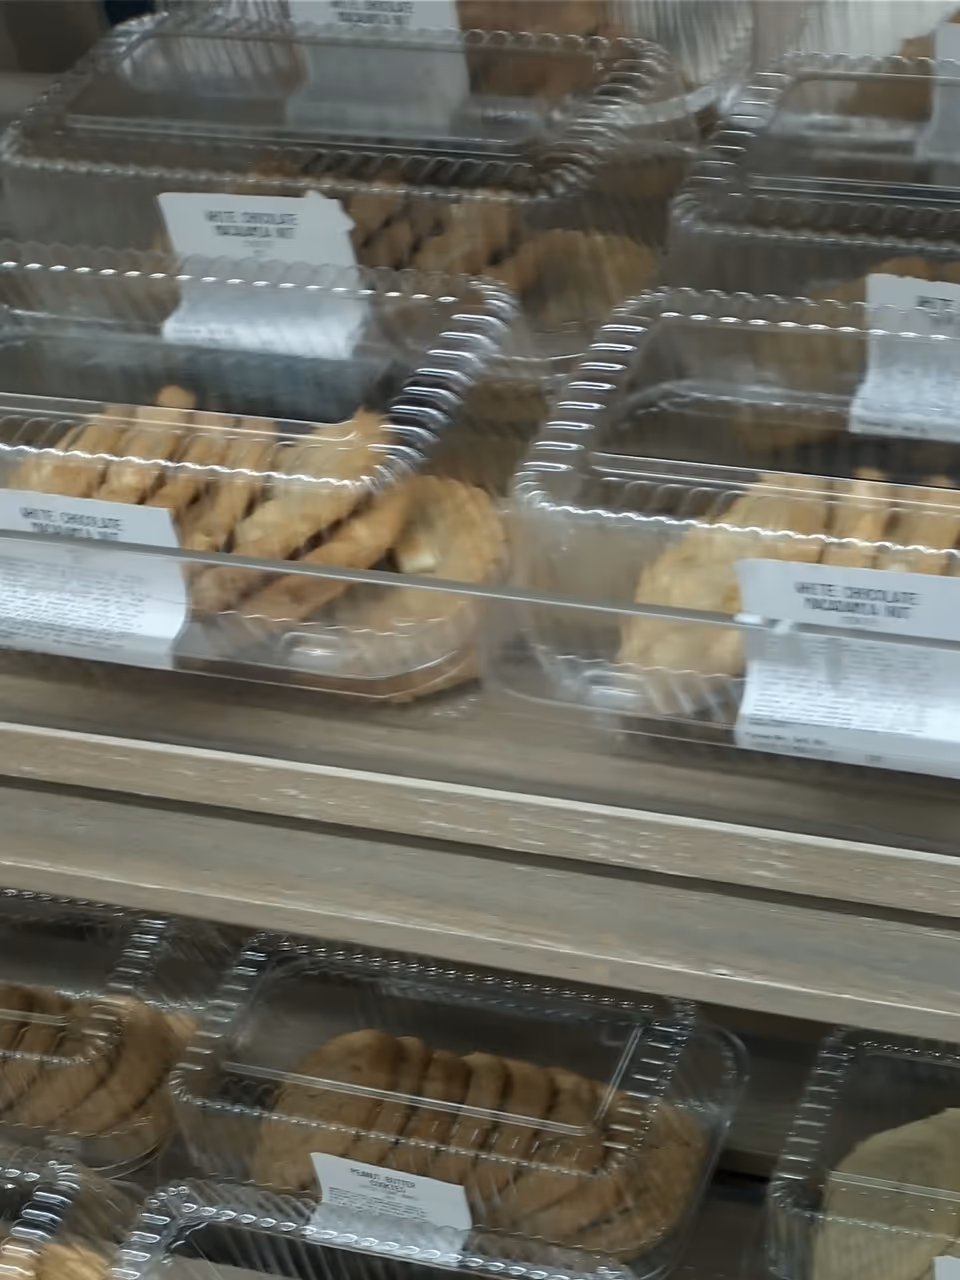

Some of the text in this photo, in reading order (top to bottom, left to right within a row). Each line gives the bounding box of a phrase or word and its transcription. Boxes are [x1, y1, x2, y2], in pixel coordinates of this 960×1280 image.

[20, 507, 123, 531] WHITE CHOCOLATE
[794, 582, 920, 606] WHITE CHOCOLATE
[804, 597, 911, 619] MACADAMIA NUT
[350, 1167, 416, 1188] PEANUT BUTTER
[369, 1180, 406, 1193] COOKIES
